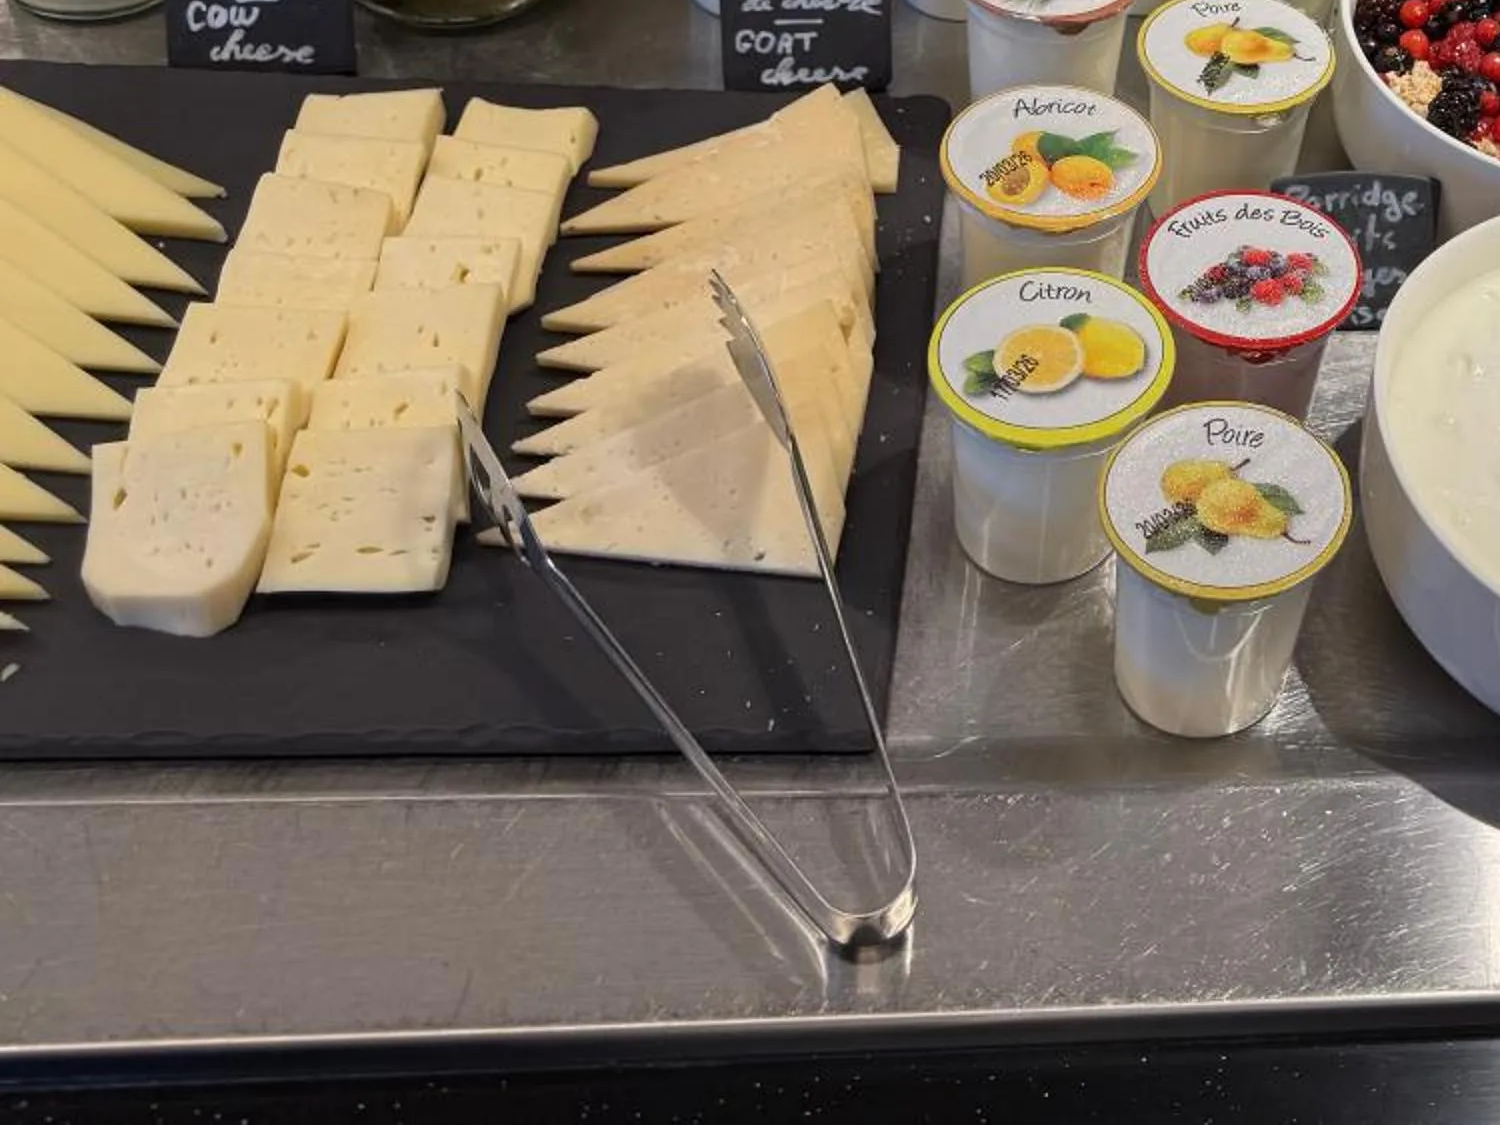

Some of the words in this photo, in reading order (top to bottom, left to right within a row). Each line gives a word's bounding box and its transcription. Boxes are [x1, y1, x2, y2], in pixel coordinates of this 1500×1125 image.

[187, 0, 260, 32] COW
[210, 28, 315, 64] cheese
[735, 29, 819, 54] GOAT
[1011, 98, 1096, 118] Abricot
[1167, 207, 1227, 238] Fruits
[1234, 202, 1275, 222] des
[1279, 209, 1331, 238] Bois
[1019, 280, 1093, 303] Citron
[1203, 418, 1265, 448] Poire
